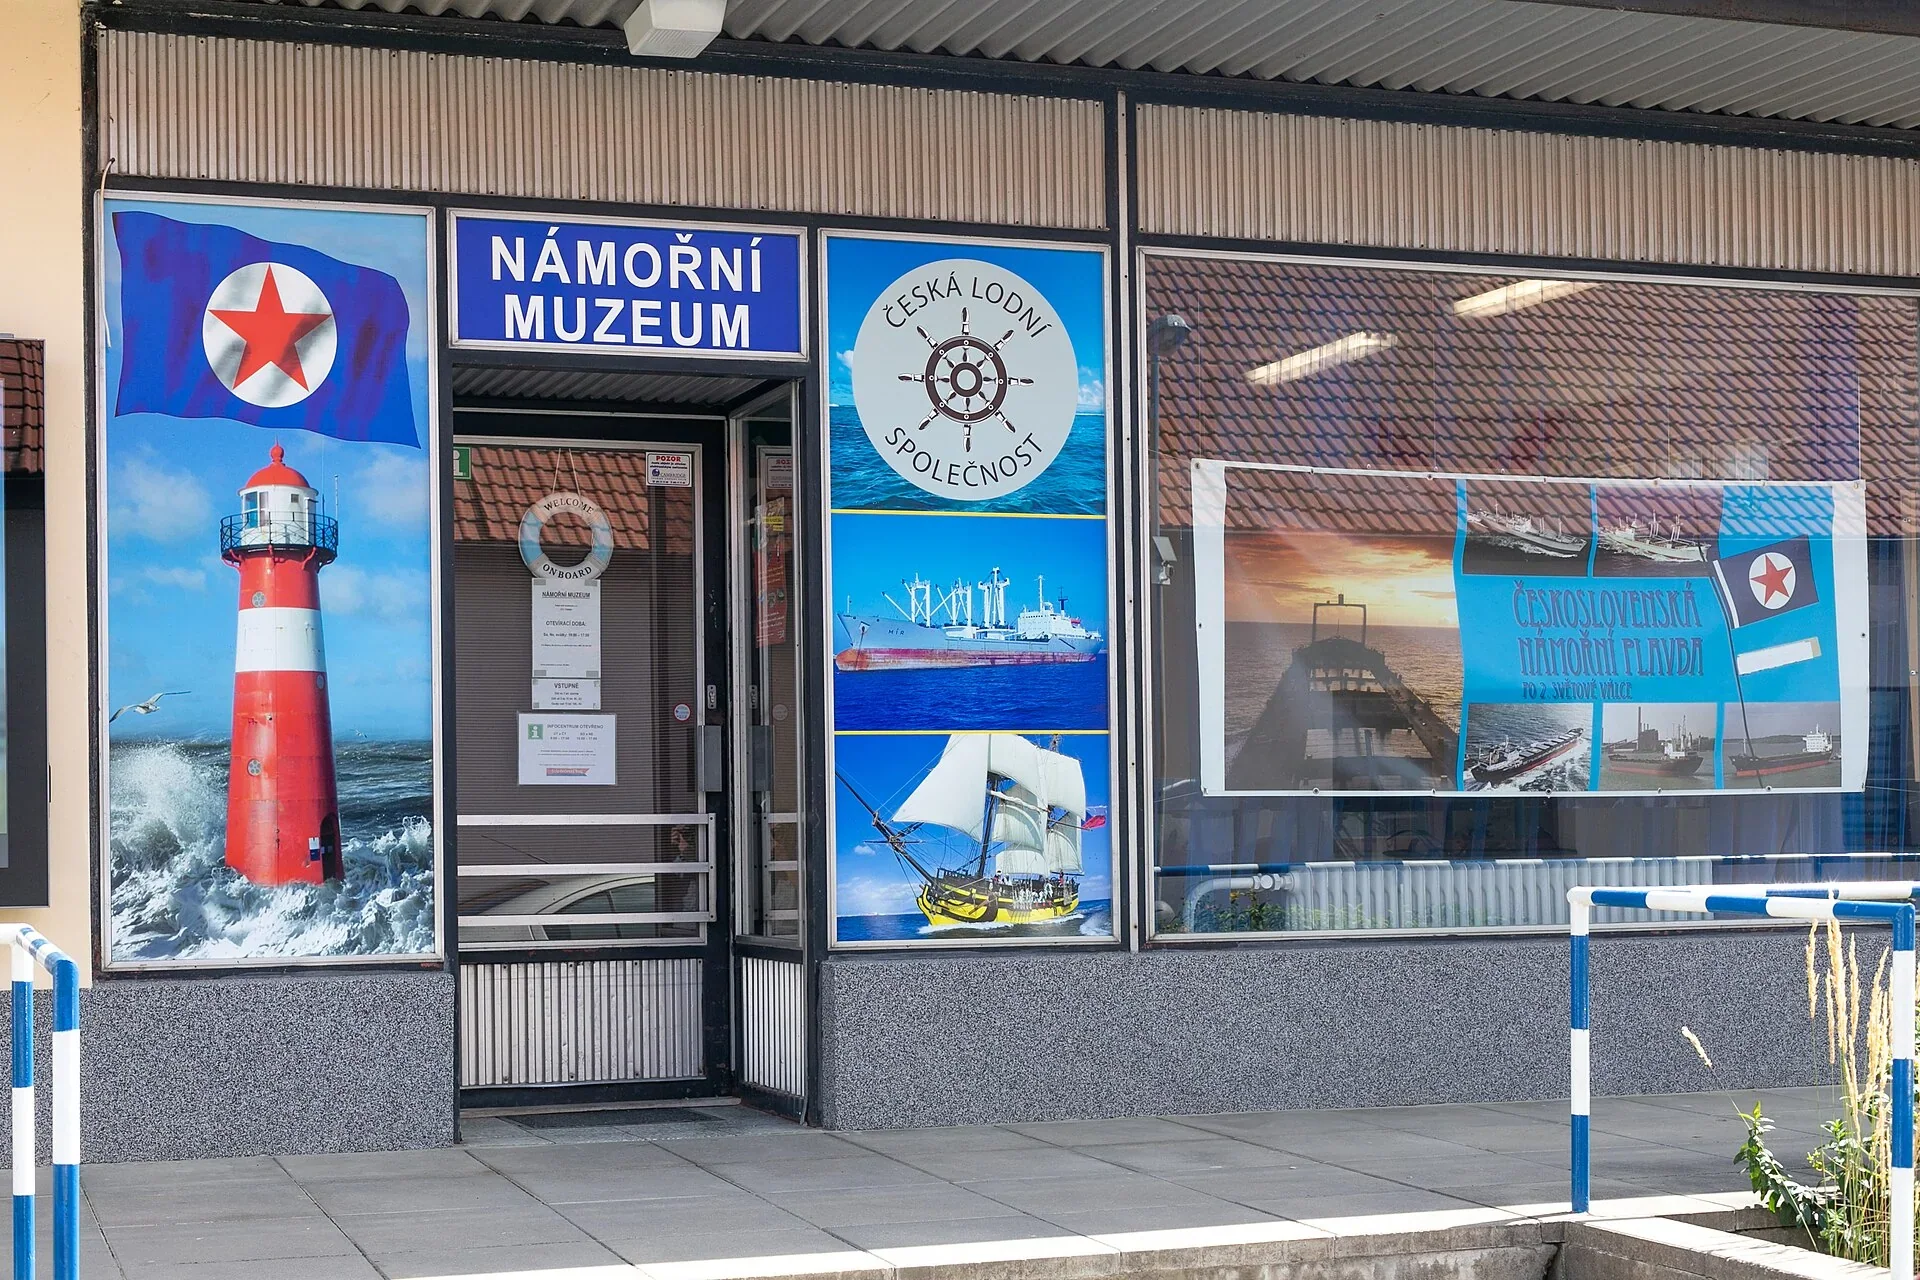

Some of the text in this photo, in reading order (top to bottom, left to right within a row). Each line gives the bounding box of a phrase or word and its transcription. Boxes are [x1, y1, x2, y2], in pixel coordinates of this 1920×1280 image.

[491, 226, 762, 293] NÁMOŘNÍ
[504, 294, 750, 348] MUZEUM
[882, 271, 1052, 338] ČESKÁ LODNÍ
[884, 427, 1043, 487] SPOLEČNOST
[543, 497, 594, 515] WELCOME
[1512, 579, 1702, 628] ČESKOSLOVENSKÁ
[1517, 628, 1704, 677] NÁMOŘNÍ PLAVBA
[1522, 681, 1537, 700] PO
[1540, 681, 1551, 700] 2.
[1552, 678, 1597, 700] SVĚTOVÉ
